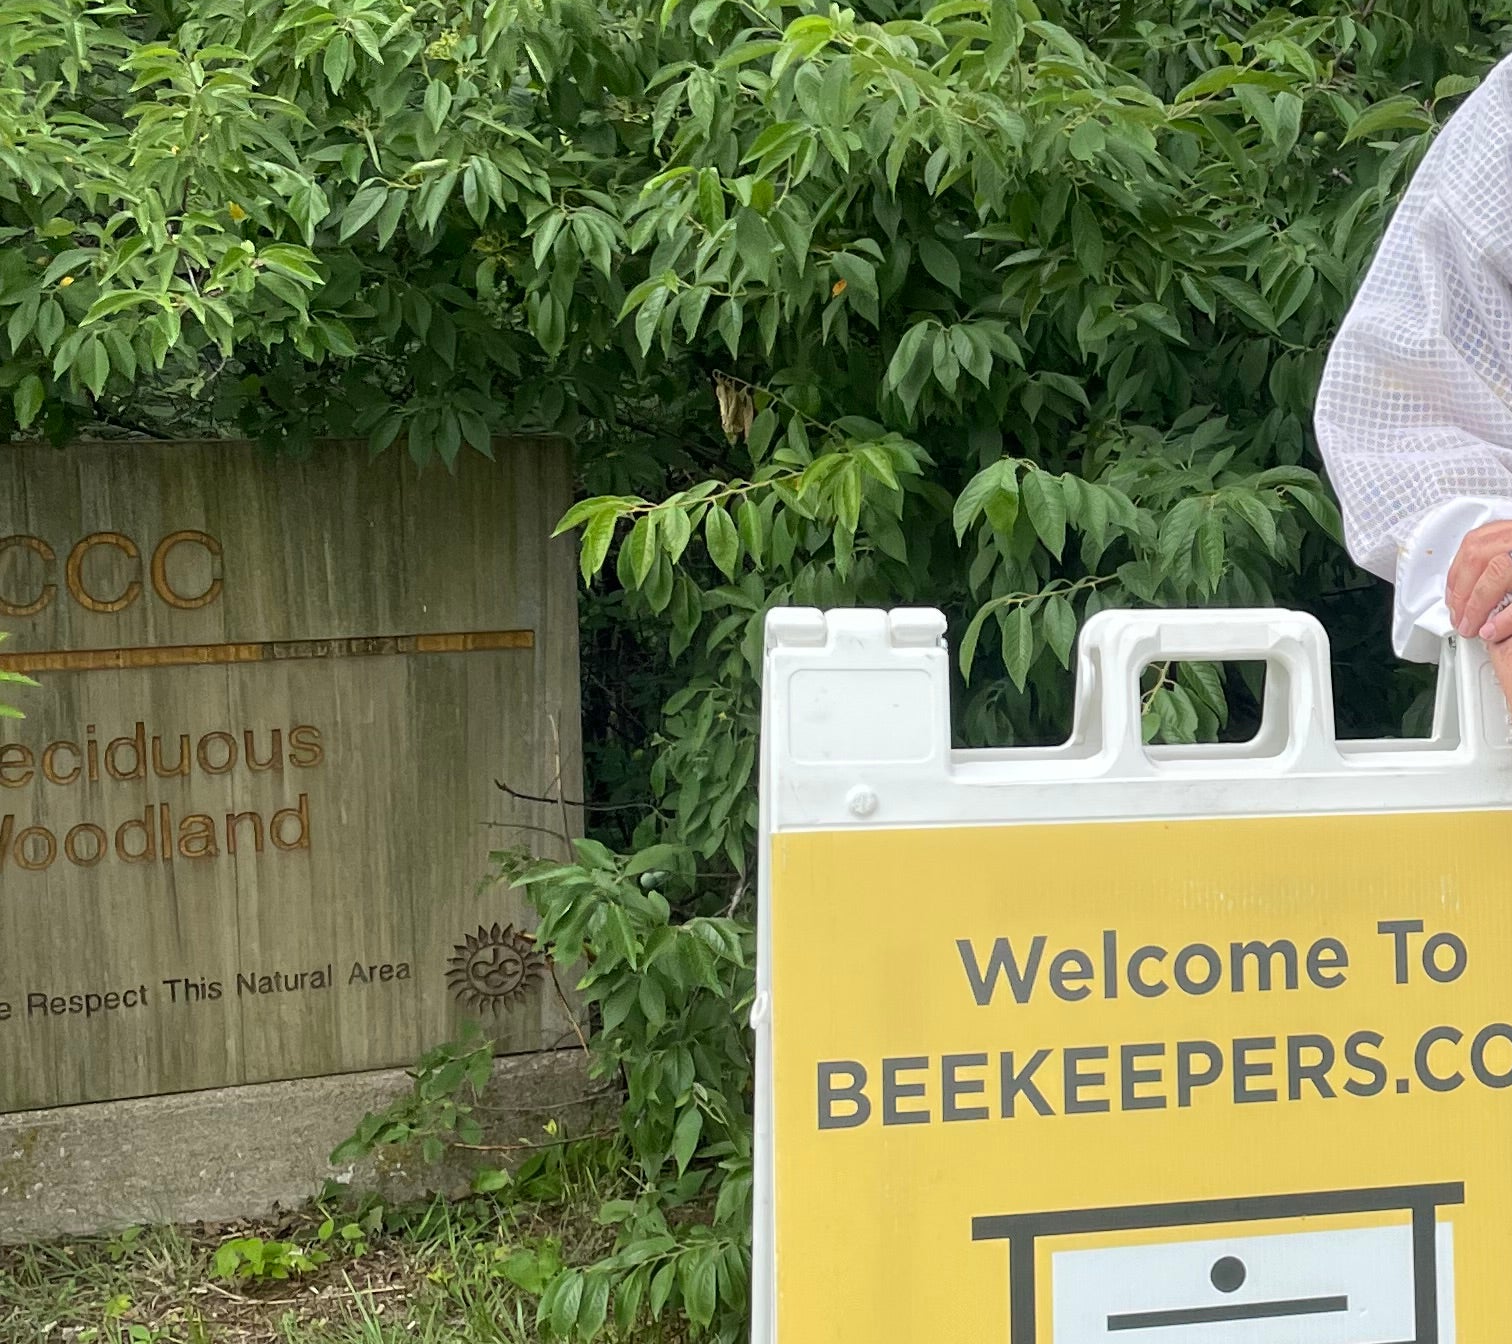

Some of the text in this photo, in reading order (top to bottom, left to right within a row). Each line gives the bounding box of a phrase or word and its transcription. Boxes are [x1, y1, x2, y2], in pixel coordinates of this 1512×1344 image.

[0, 793, 311, 871] oodland
[27, 984, 148, 1019] Respect
[163, 977, 223, 1004] This
[236, 964, 333, 999] Natural
[348, 960, 412, 987] Area
[956, 919, 1468, 1006] Welcome To
